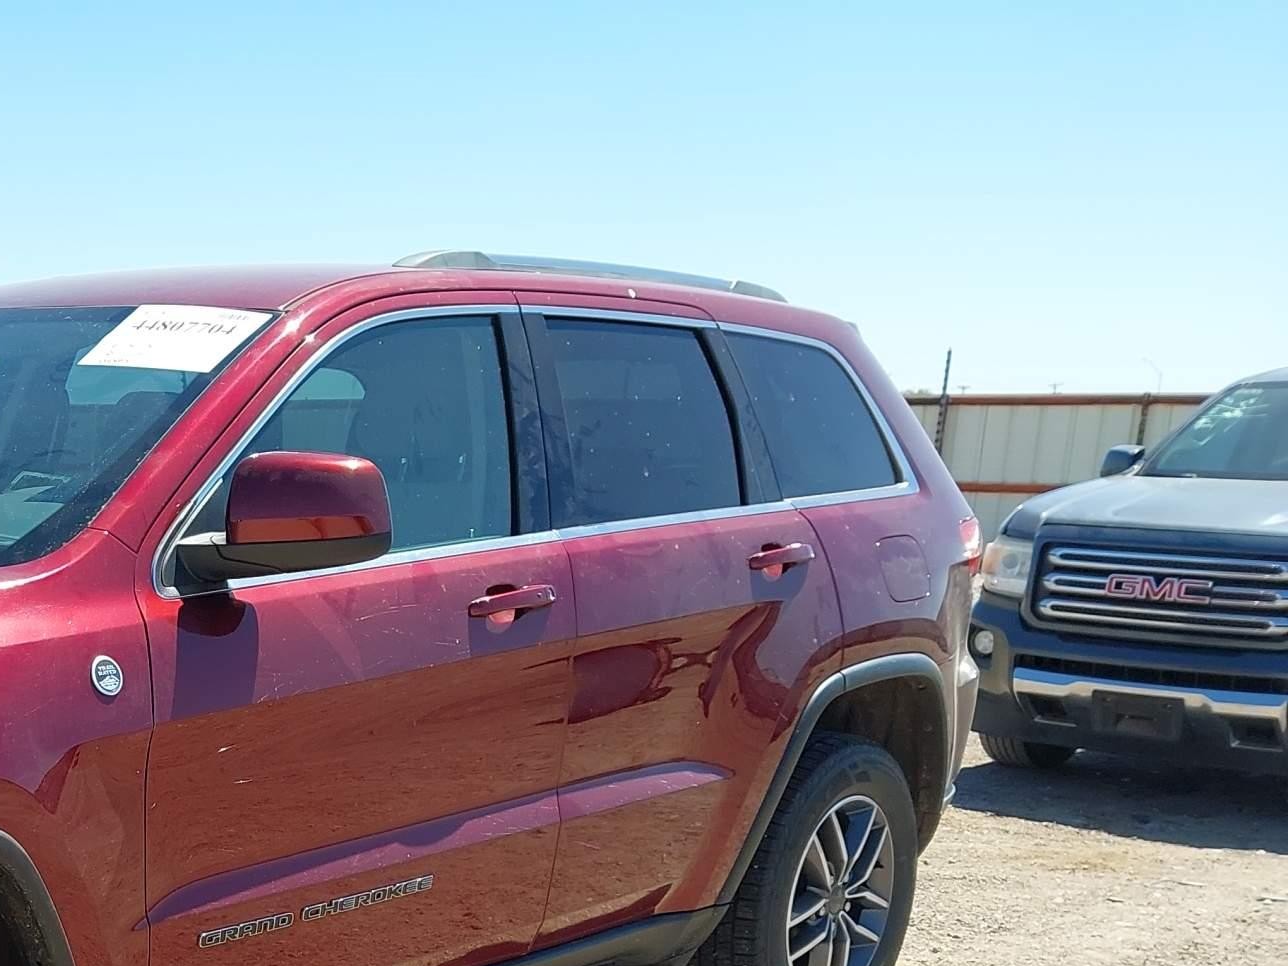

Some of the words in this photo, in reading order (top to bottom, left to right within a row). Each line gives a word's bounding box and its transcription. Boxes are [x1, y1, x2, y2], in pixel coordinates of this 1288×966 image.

[132, 320, 238, 335] 44807704
[1105, 573, 1213, 605] GMC
[198, 912, 294, 948] GRAND
[301, 874, 434, 922] CHEROKEE
